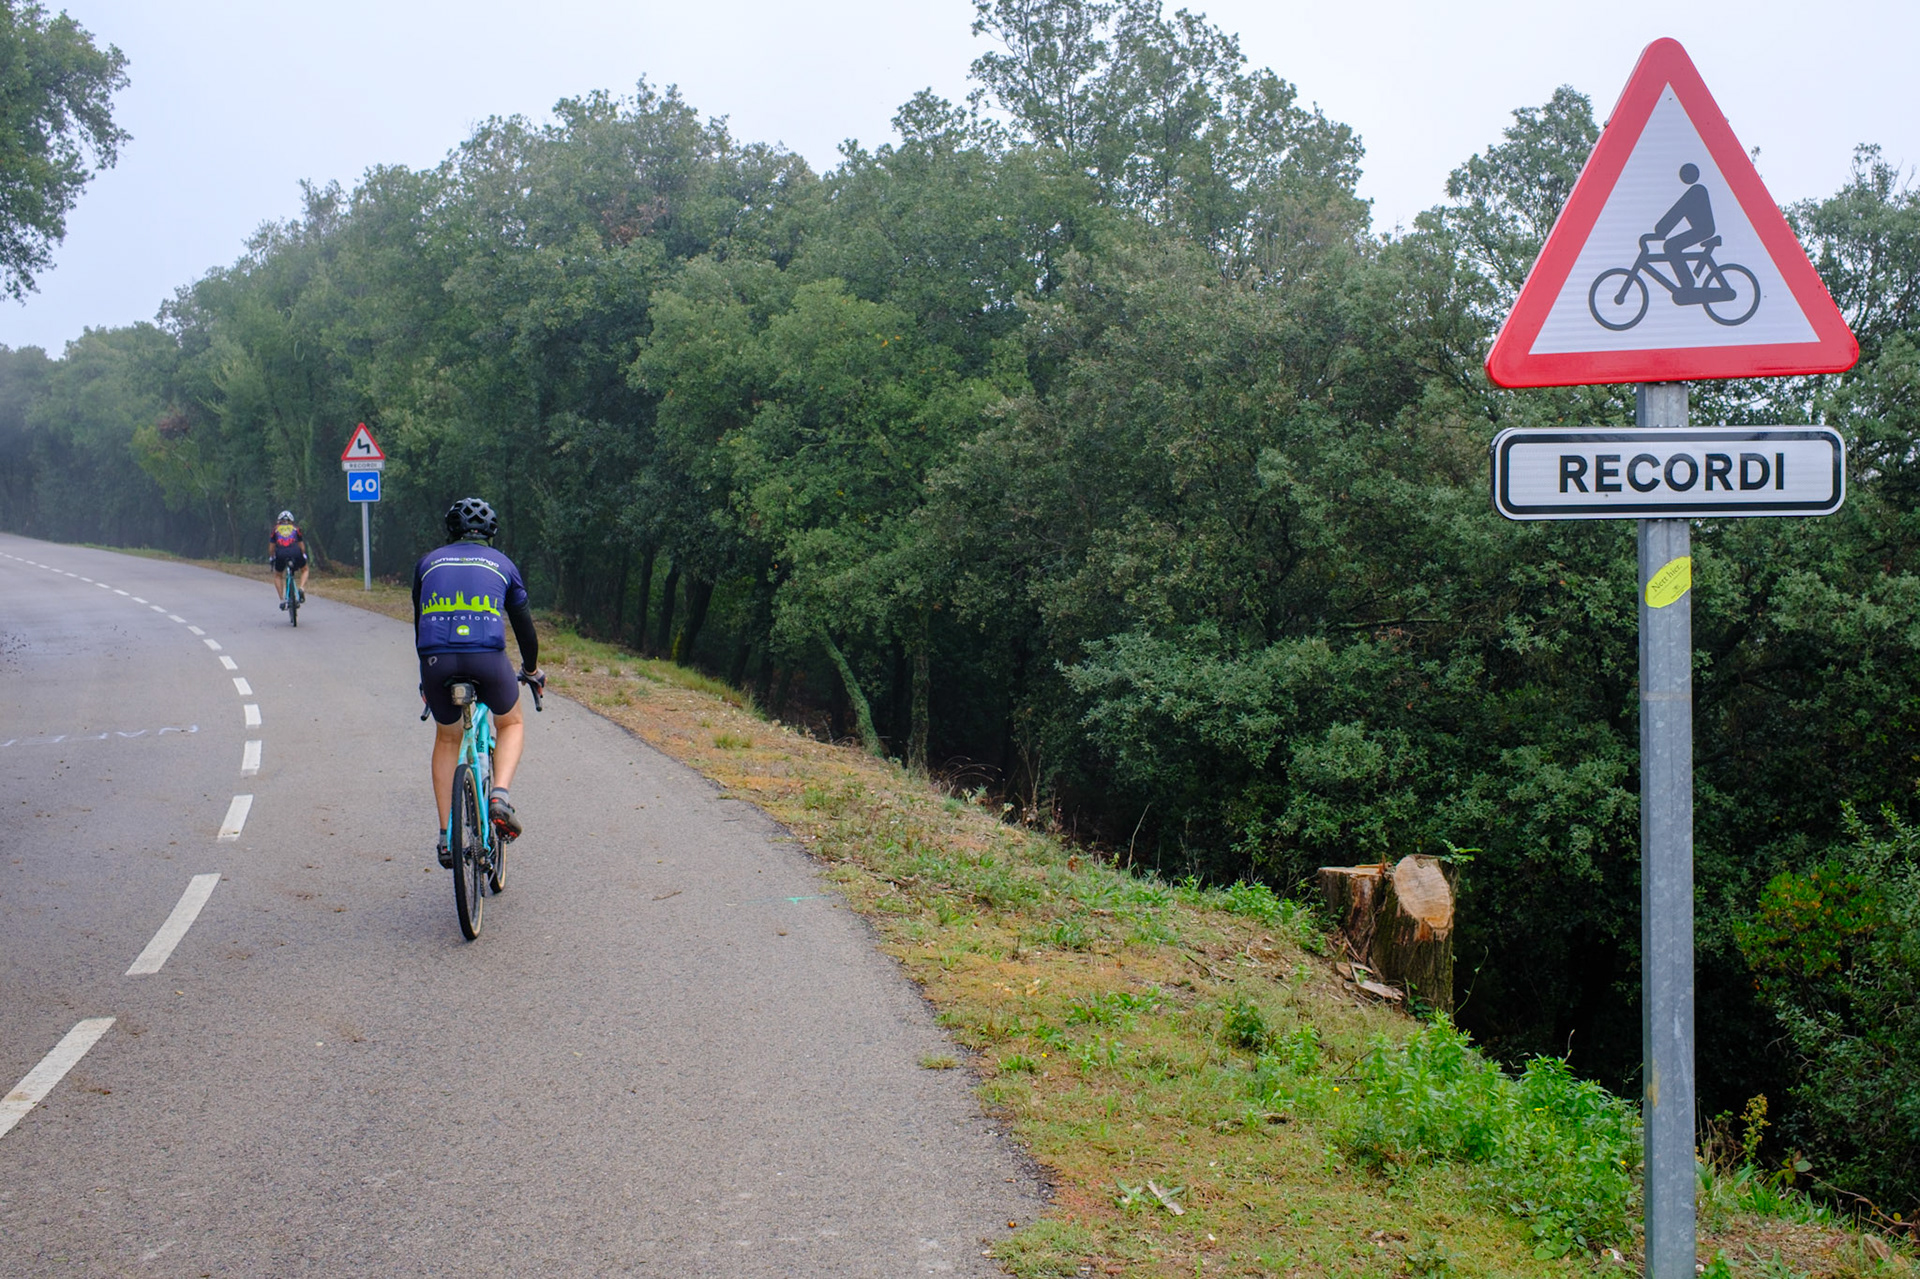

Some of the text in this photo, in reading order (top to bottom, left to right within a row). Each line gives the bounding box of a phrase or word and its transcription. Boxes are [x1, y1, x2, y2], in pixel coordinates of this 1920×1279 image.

[1559, 452, 1785, 493] RECORDI
[351, 478, 377, 493] 40
[431, 614, 498, 622] Barcelona
